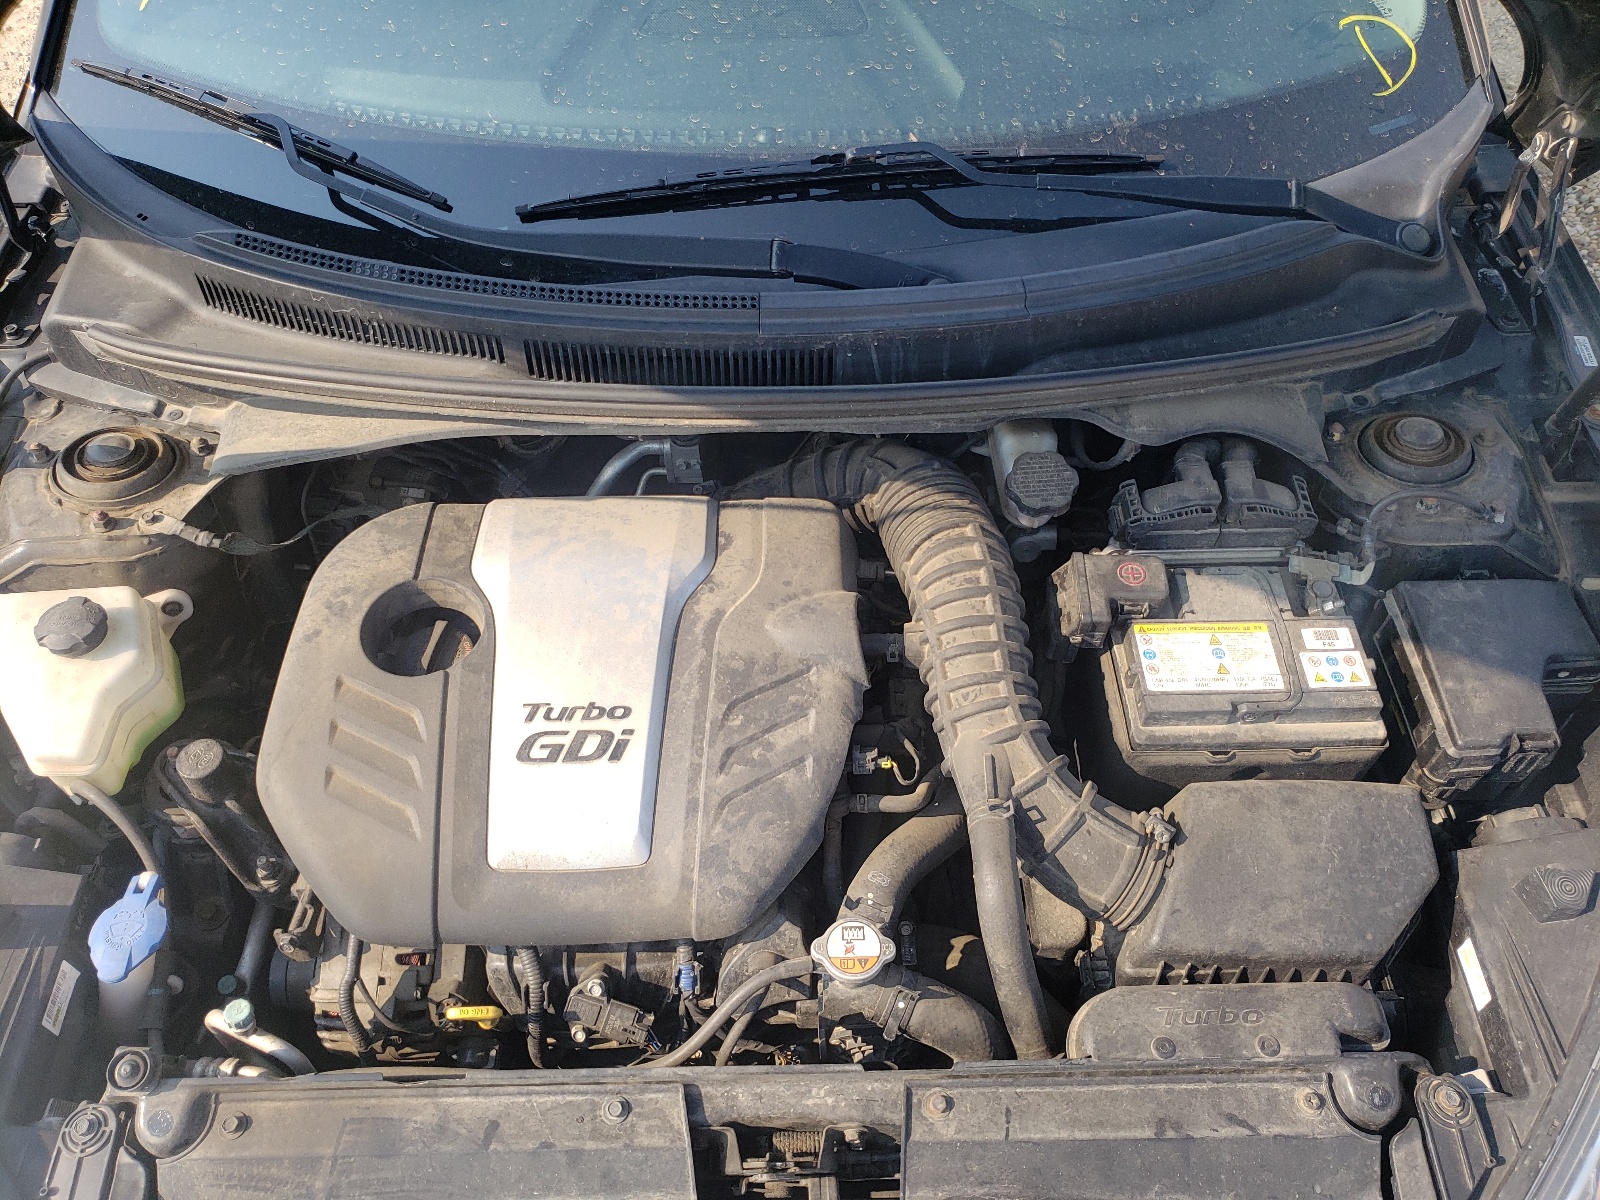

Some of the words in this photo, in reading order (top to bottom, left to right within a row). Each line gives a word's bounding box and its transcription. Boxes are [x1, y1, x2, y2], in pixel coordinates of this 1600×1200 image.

[1339, 14, 1417, 97] D
[522, 701, 633, 724] Turbo
[515, 728, 636, 764] GDi
[1156, 1004, 1264, 1027] Turbo
